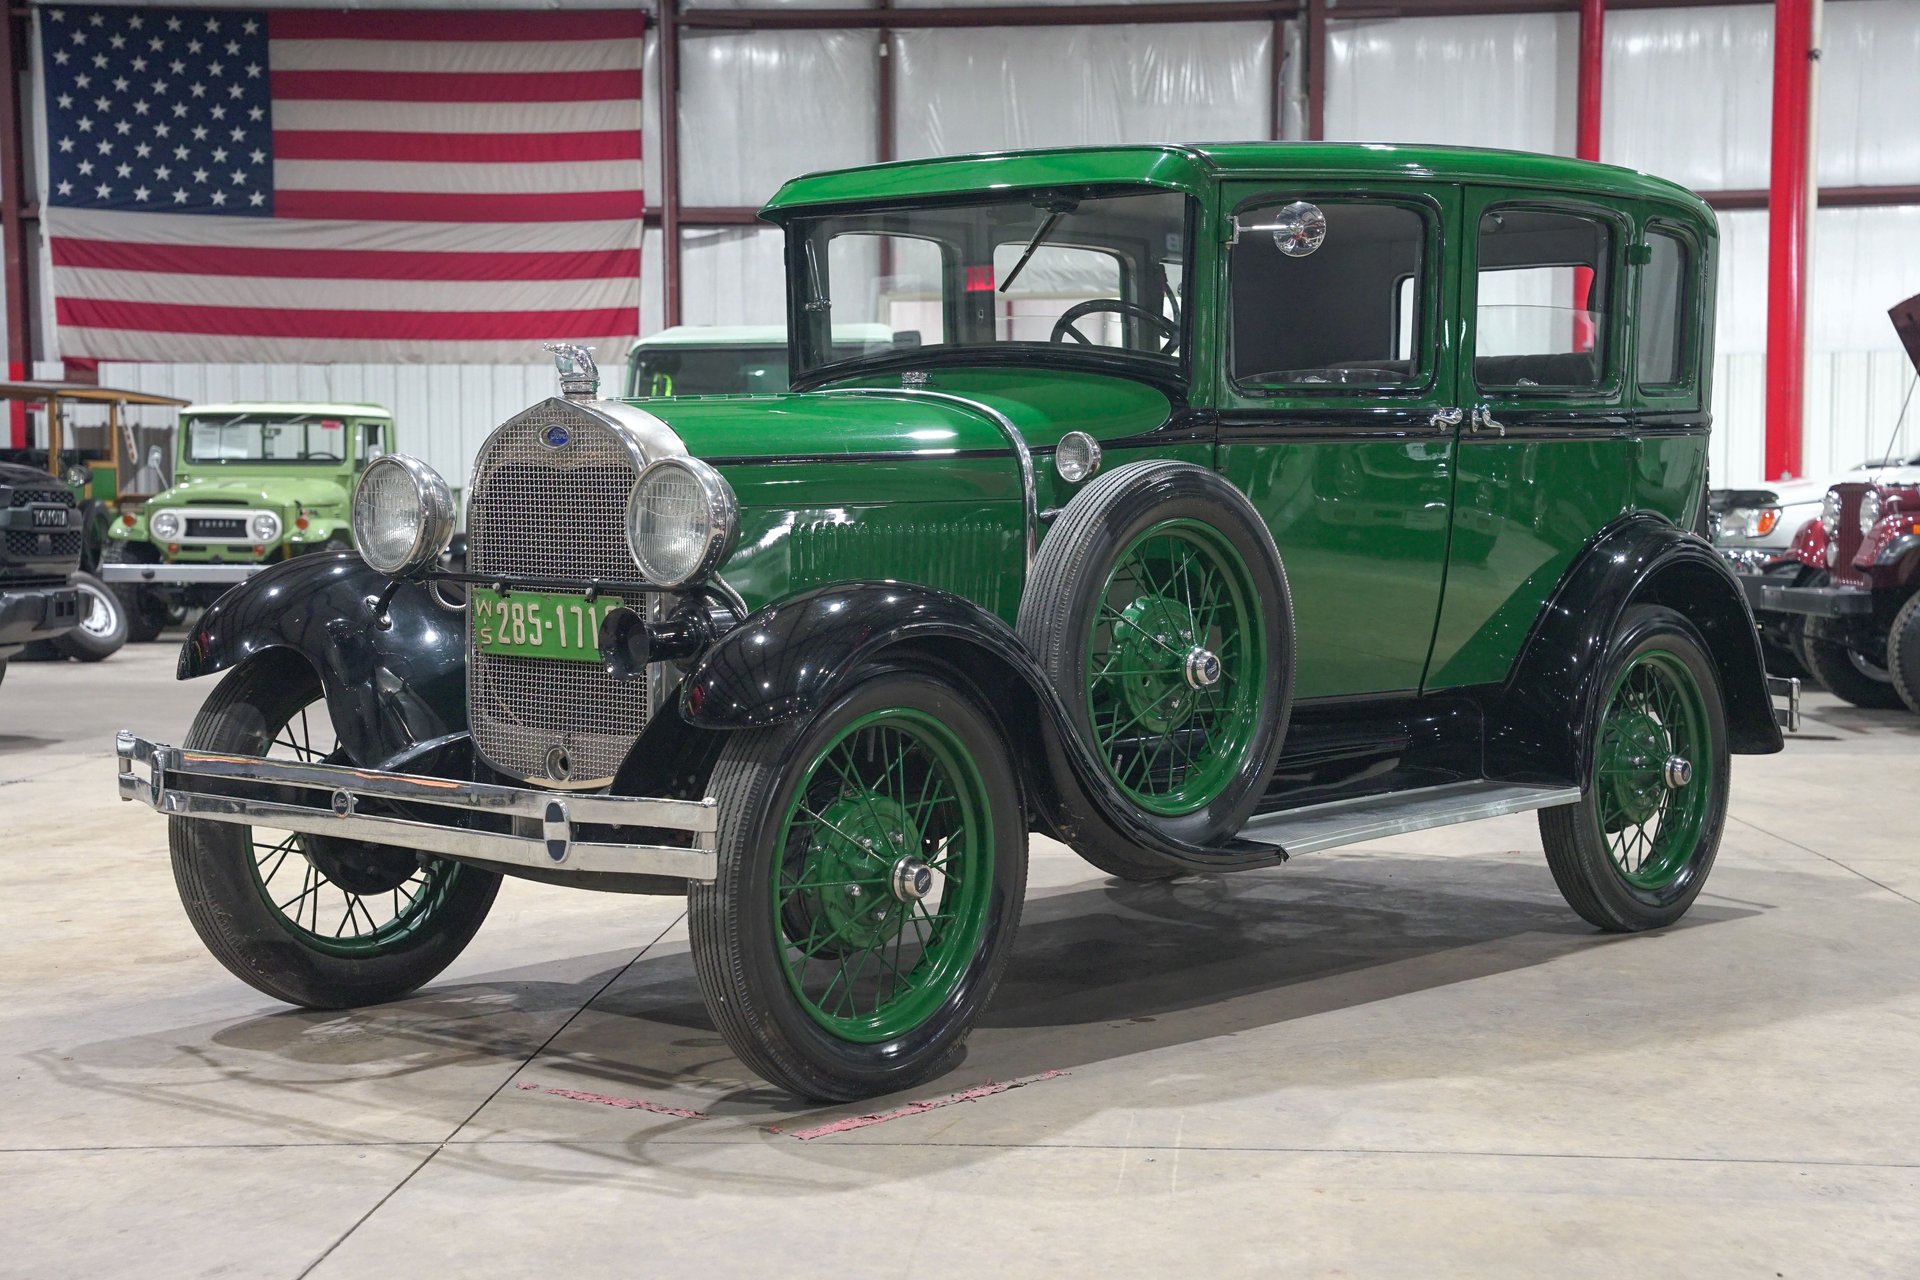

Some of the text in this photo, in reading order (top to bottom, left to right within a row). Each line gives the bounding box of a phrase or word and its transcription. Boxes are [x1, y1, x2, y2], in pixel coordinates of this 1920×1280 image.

[34, 509, 67, 526] TOYOTA
[198, 520, 237, 529] TOYOTA
[496, 601, 617, 650] 285-171
